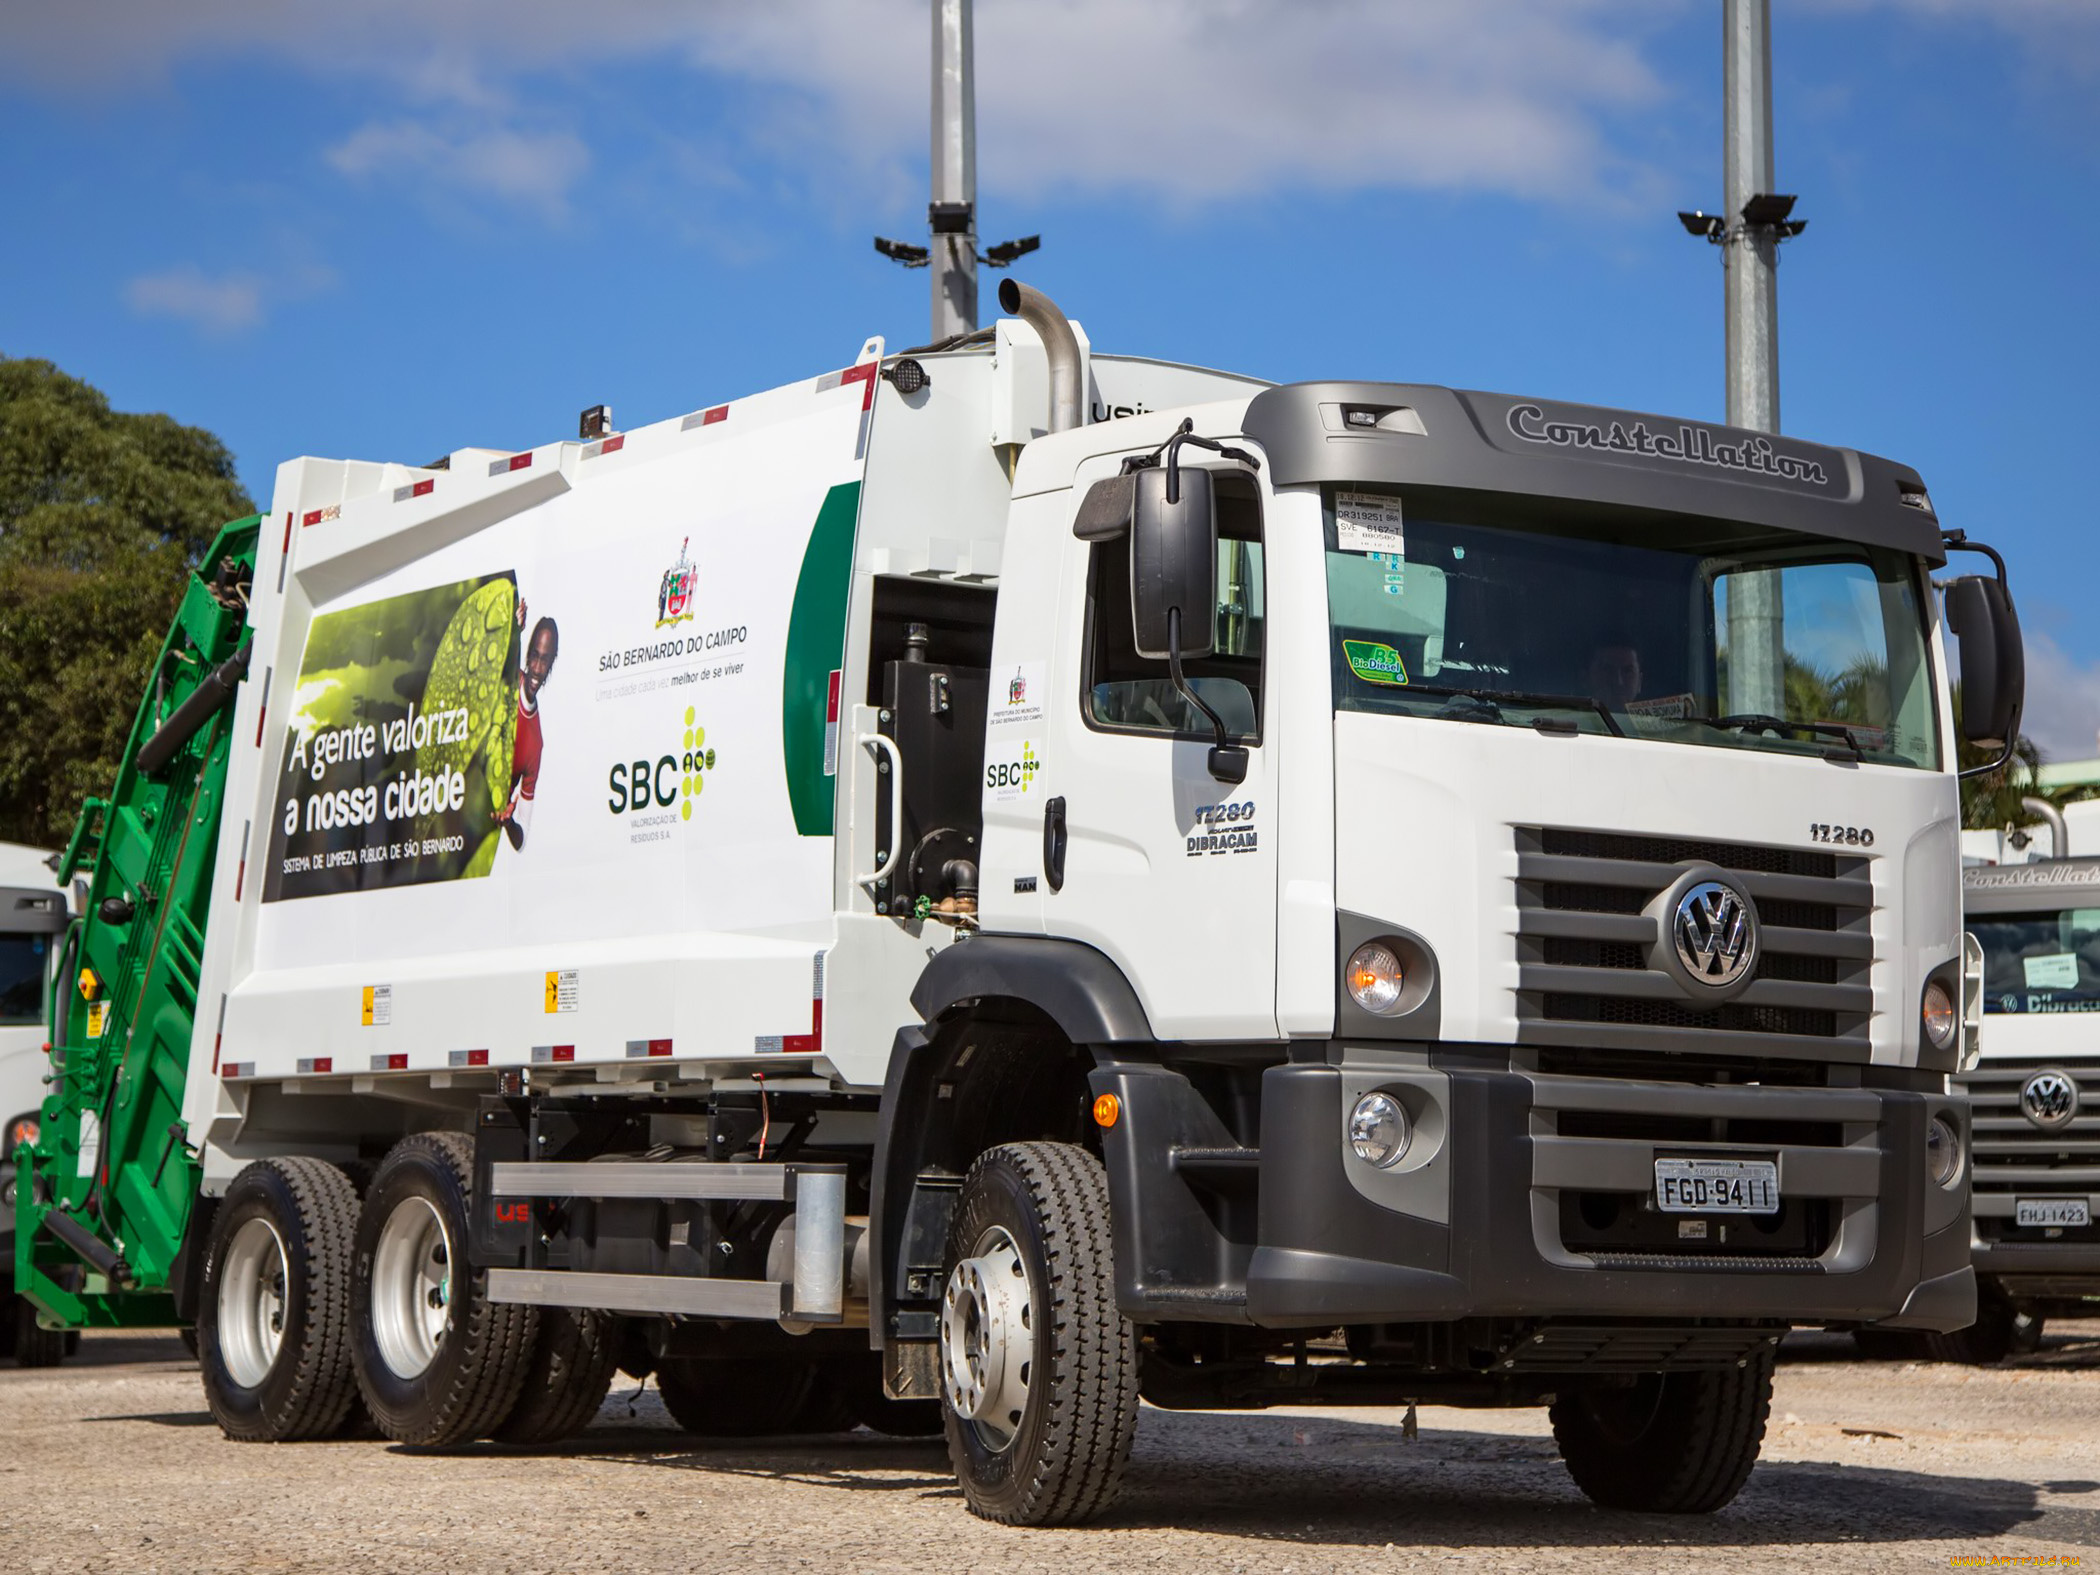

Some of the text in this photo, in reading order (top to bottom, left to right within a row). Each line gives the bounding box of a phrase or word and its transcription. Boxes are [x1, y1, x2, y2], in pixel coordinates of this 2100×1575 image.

[1506, 403, 1829, 485] Constellation
[599, 625, 747, 672] SÃO BERNARDO DO CAMPO
[1352, 657, 1401, 673] BioDiesel
[671, 672, 699, 687] melhor
[700, 668, 711, 681] de
[712, 667, 722, 678] se
[724, 662, 744, 676] viver
[288, 700, 469, 781] A gente valoriza
[608, 754, 678, 815] SBC
[987, 762, 1021, 788] SBC
[284, 763, 466, 836] a nossa cidade
[282, 835, 465, 875] SISTEMA DE LIMPEZA PÚBLICA DE SÃO BERNARDO
[1187, 832, 1258, 852] DIBRACAM
[1963, 864, 2100, 889] Constellat
